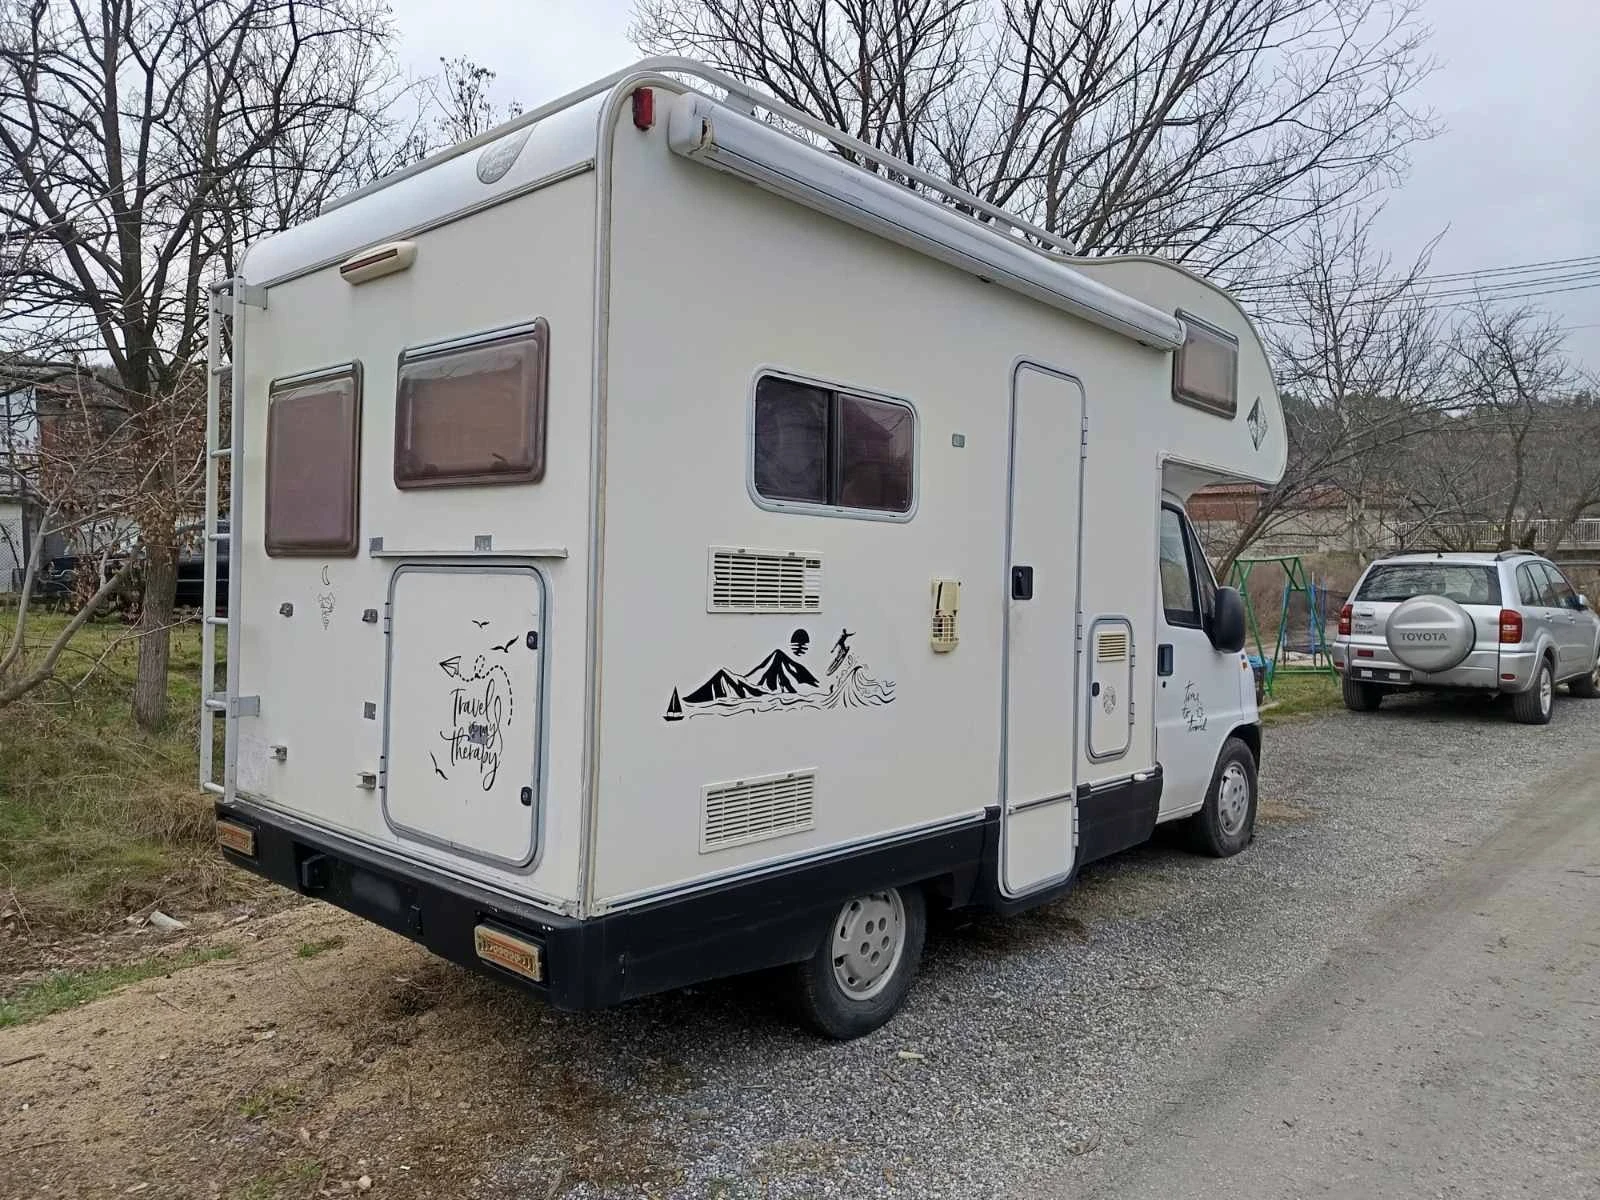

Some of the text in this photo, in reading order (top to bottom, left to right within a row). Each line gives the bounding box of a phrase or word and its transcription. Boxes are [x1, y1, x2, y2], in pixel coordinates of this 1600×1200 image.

[1400, 632, 1448, 642] TOYOTA
[449, 678, 495, 727] Travel
[440, 727, 503, 791] therapy
